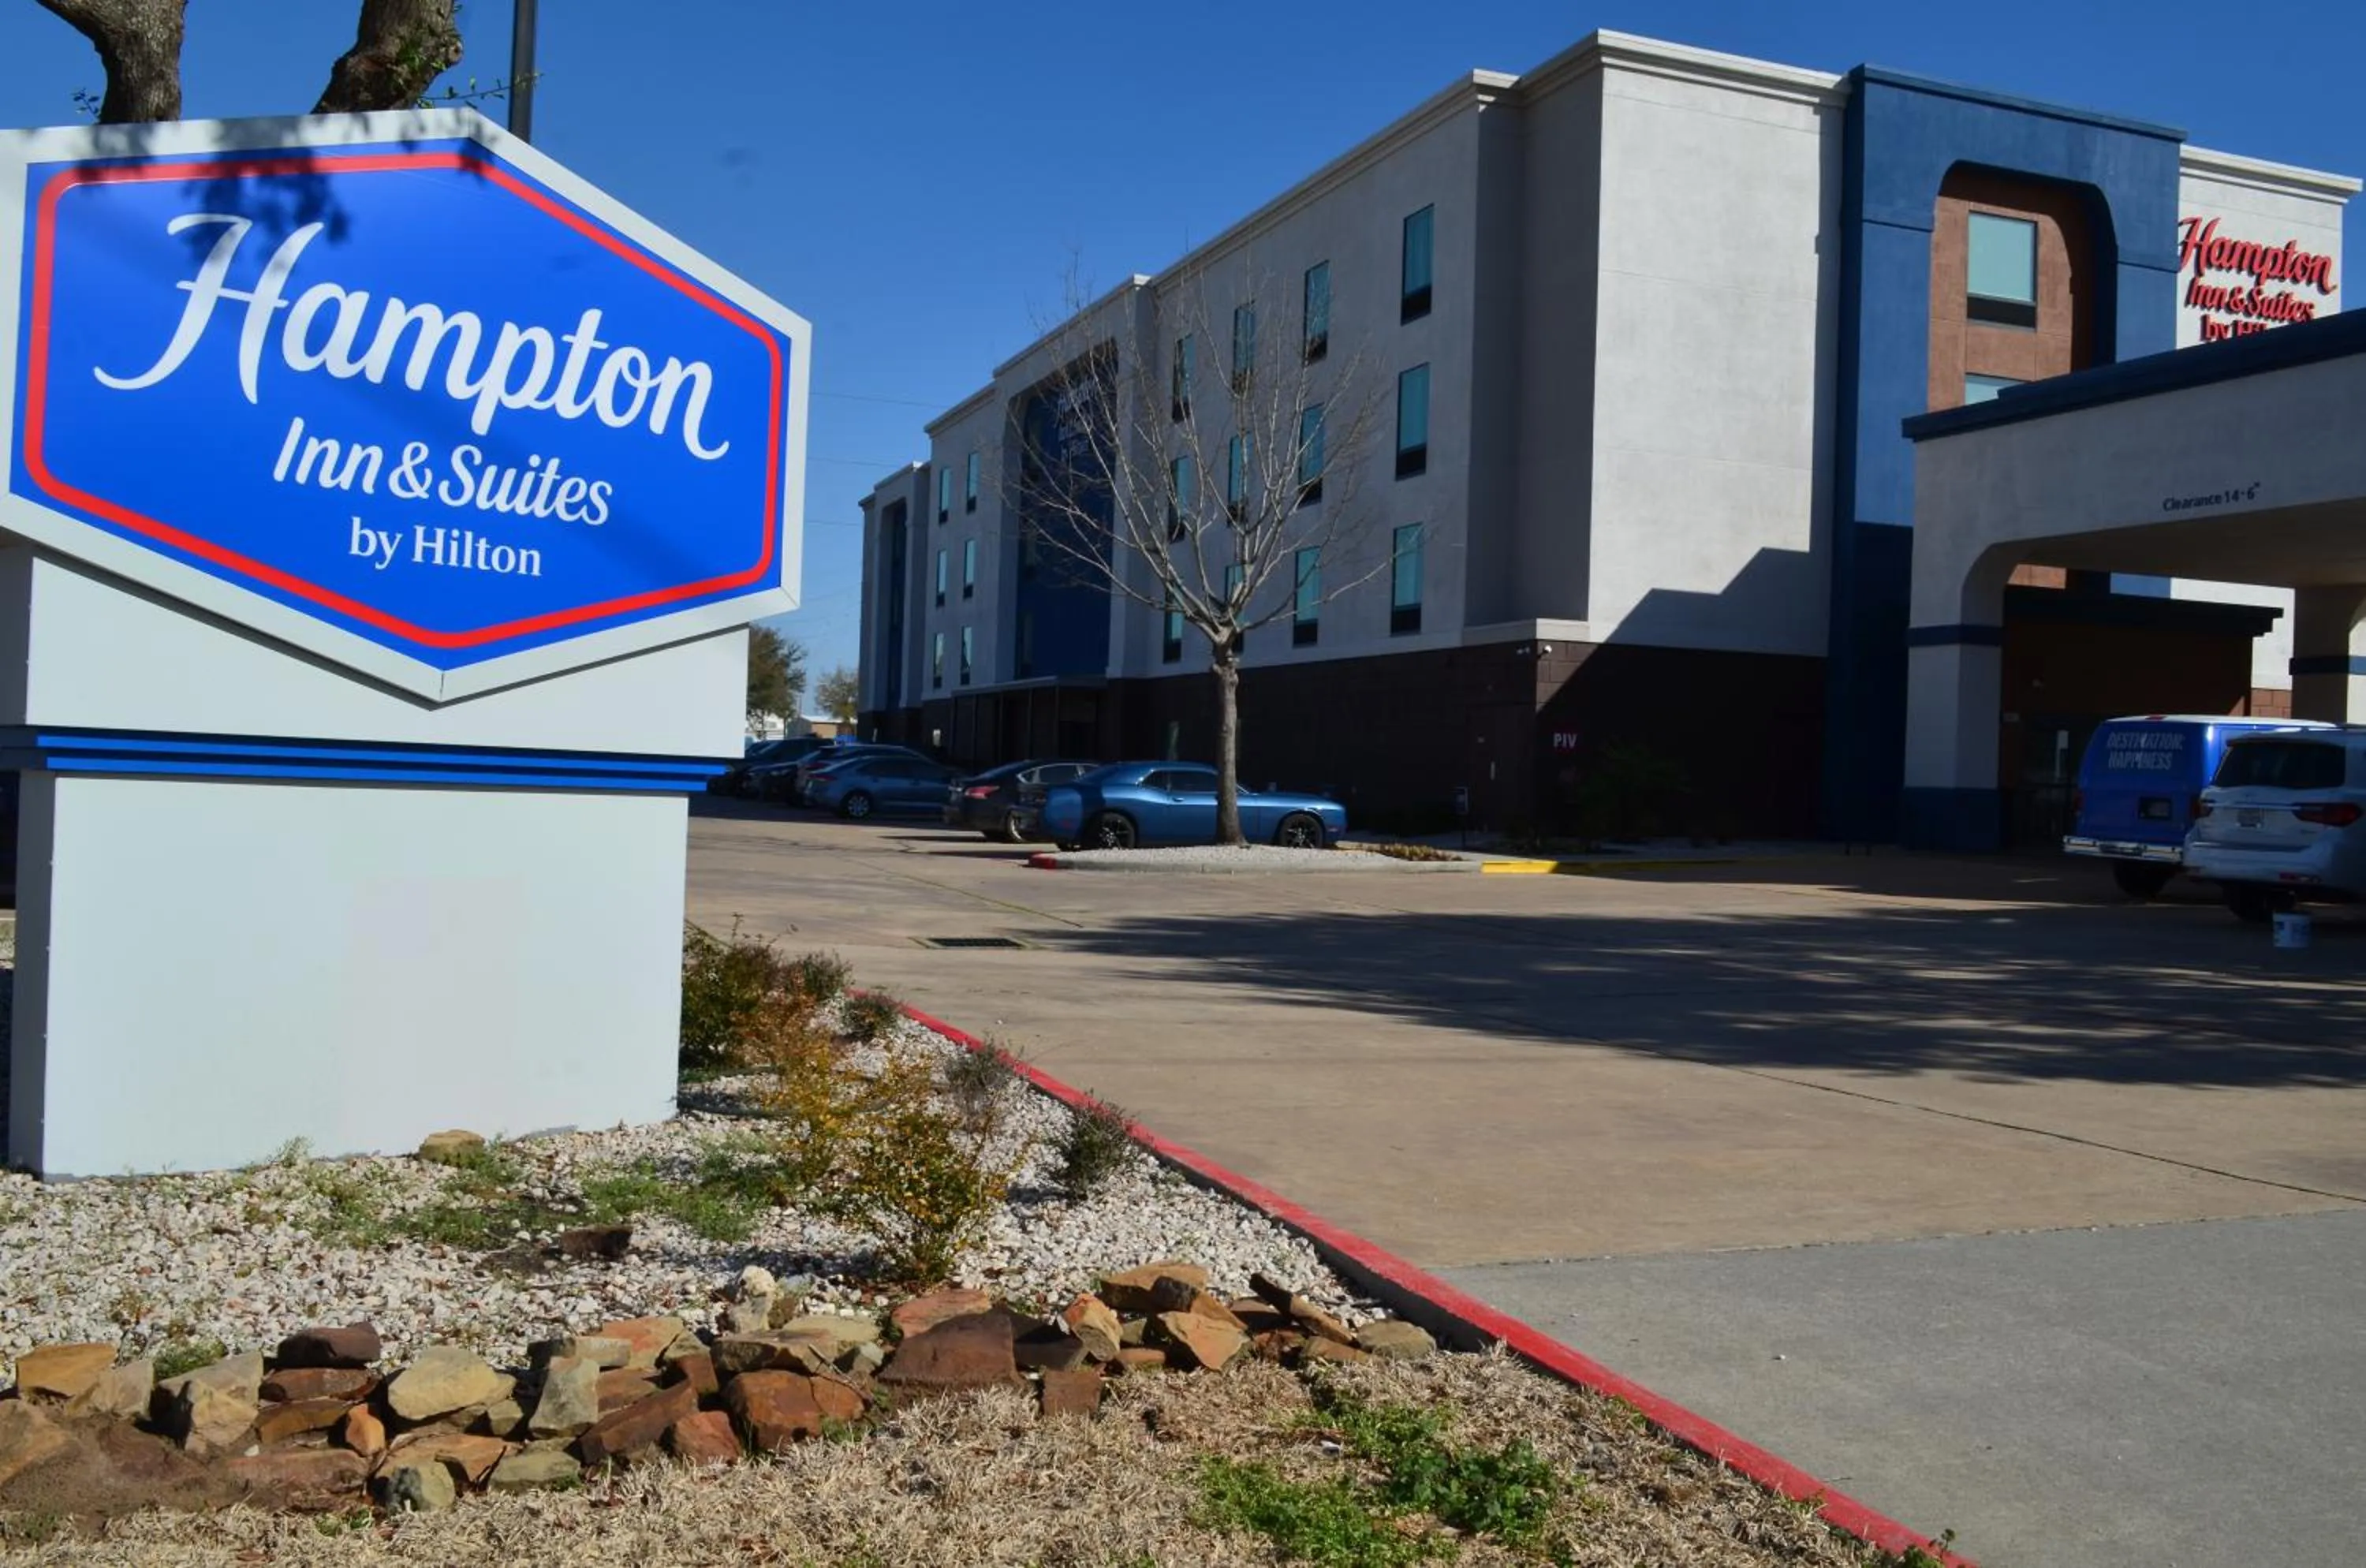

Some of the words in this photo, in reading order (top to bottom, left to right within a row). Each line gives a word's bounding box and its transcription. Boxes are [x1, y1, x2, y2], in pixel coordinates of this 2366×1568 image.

[2178, 217, 2337, 294] Hampton
[2185, 277, 2227, 311] Inn
[2226, 284, 2248, 315] &
[2248, 286, 2314, 323] Suites
[94, 213, 730, 460] Hampton
[273, 415, 376, 495] Inn
[388, 440, 433, 498] &
[438, 442, 613, 526] Suites
[2163, 493, 2222, 512] Clearance
[349, 517, 402, 569] by
[412, 525, 542, 577] Hilton
[1553, 732, 1577, 748] PIV
